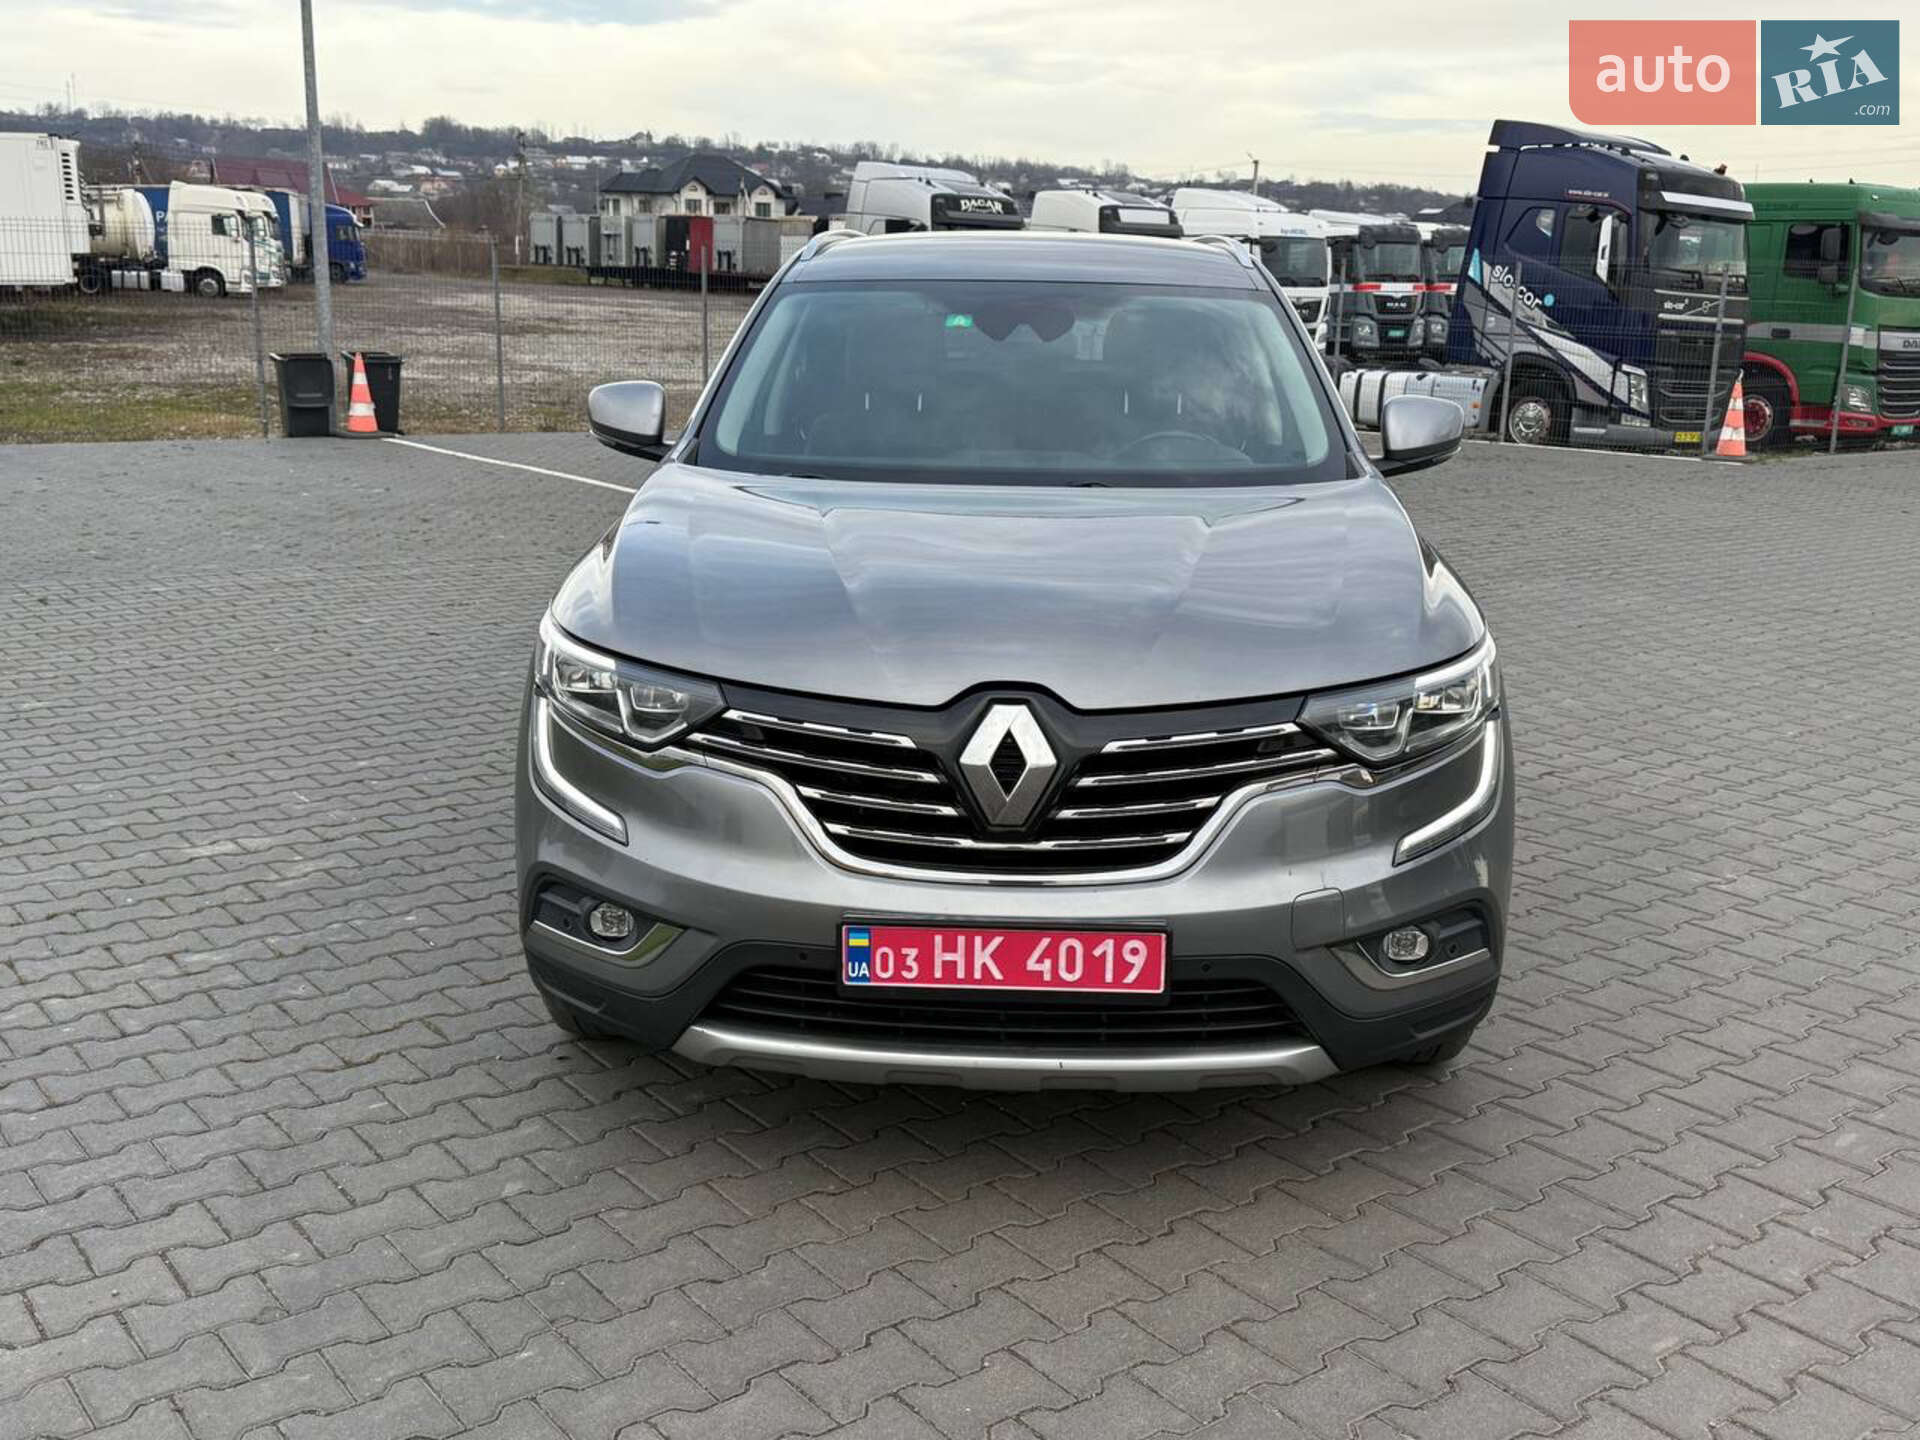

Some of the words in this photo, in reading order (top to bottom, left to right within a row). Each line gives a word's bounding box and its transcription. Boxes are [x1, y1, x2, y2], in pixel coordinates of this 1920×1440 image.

[847, 961, 869, 978] UA
[875, 946, 919, 979] 03
[933, 934, 1005, 981] HK
[1025, 937, 1148, 984] 4019
